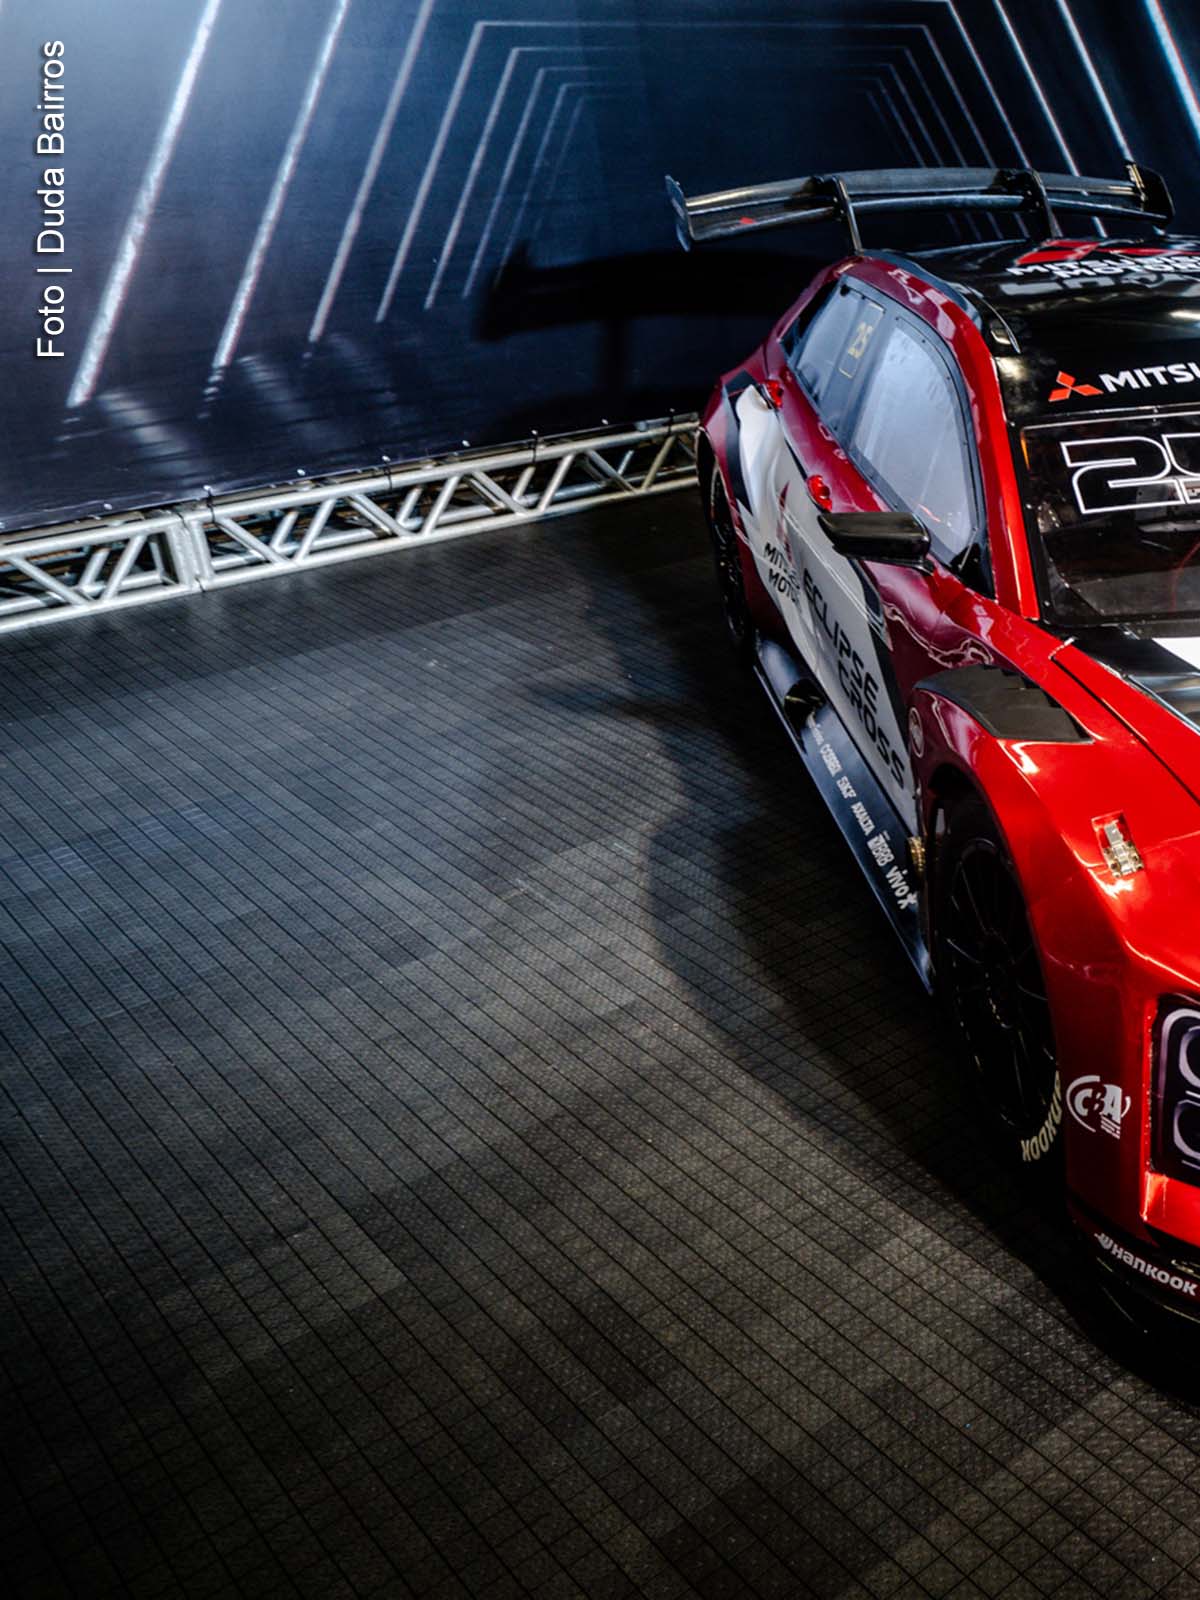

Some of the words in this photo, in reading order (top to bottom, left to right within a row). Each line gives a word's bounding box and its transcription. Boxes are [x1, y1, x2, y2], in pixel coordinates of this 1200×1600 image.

[803, 567, 879, 714] ECLIPSE
[837, 659, 905, 790] CROSS
[886, 866, 909, 897] vivo
